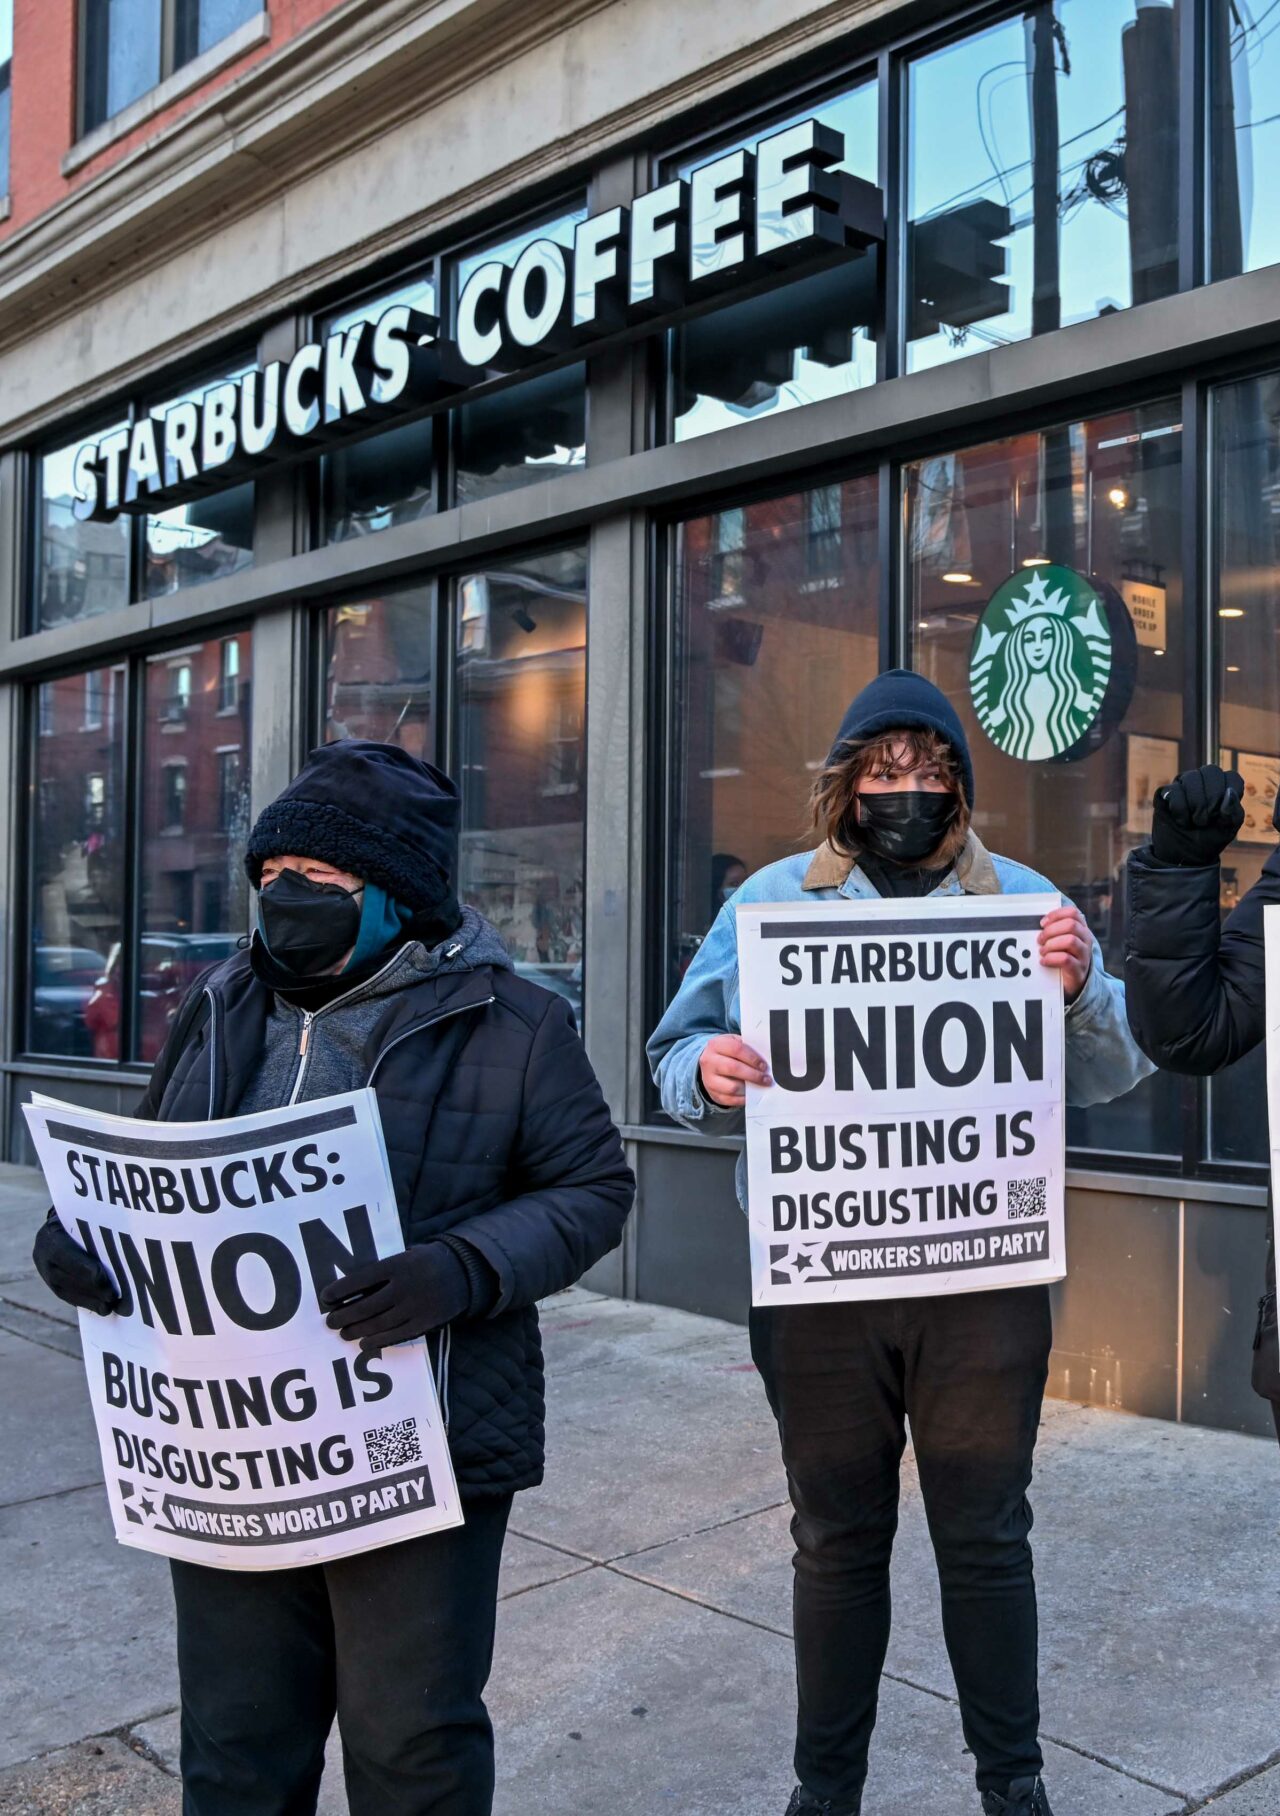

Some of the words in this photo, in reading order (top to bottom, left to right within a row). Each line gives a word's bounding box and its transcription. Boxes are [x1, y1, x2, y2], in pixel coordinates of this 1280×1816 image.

[71, 304, 412, 522] STARBUCKS
[457, 117, 819, 367] COFFEE
[778, 937, 1032, 986] STARBUCKS:
[768, 998, 1045, 1093] UNION
[769, 1115, 981, 1175] BUSTING
[995, 1110, 1036, 1159] IS
[66, 1143, 347, 1216] STARBUCKS:
[771, 1179, 998, 1232] DISGUSTING
[830, 1244, 922, 1273] WORKERS
[924, 1236, 986, 1266] WORLD
[989, 1229, 1046, 1258] PARTY
[101, 1350, 318, 1430] BUSTING
[331, 1347, 394, 1410] IS
[111, 1426, 355, 1492] DISGUSTING
[168, 1503, 264, 1538] WORKERS
[265, 1501, 351, 1537] WORLD
[352, 1476, 428, 1520] PARTY
